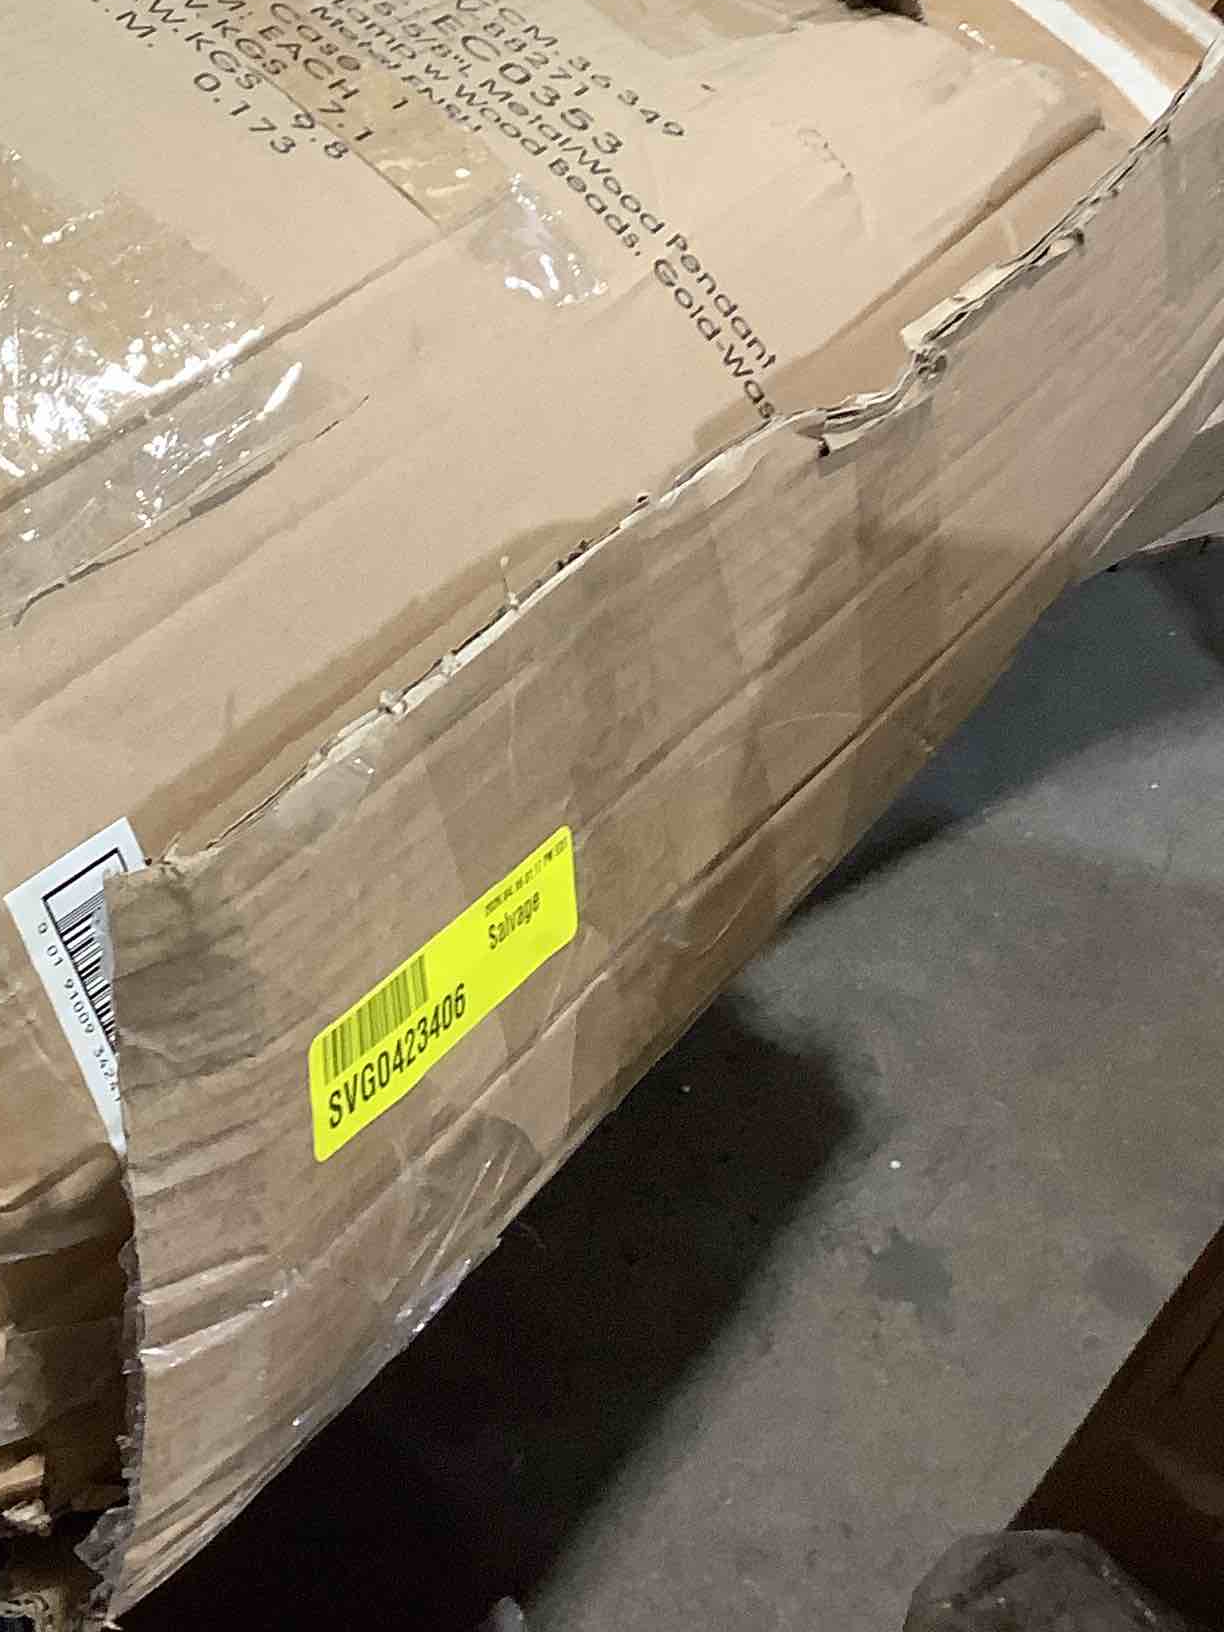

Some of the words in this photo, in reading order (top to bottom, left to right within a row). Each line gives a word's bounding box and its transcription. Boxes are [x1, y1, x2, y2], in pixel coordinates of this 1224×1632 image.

[257, 24, 361, 101] EACH
[269, 1, 362, 72] Case
[391, 96, 410, 111] 1
[430, 13, 624, 155] EC0353
[192, 71, 298, 155] 0.173
[289, 111, 351, 160] 9.8
[317, 99, 376, 143] 7.1
[454, 82, 549, 157] Wood
[547, 156, 642, 257] Beads,
[478, 77, 666, 235] Metal/Wood
[665, 231, 777, 370] Pendant
[487, 890, 541, 951] Salvage
[327, 982, 467, 1130] SVG0423406
